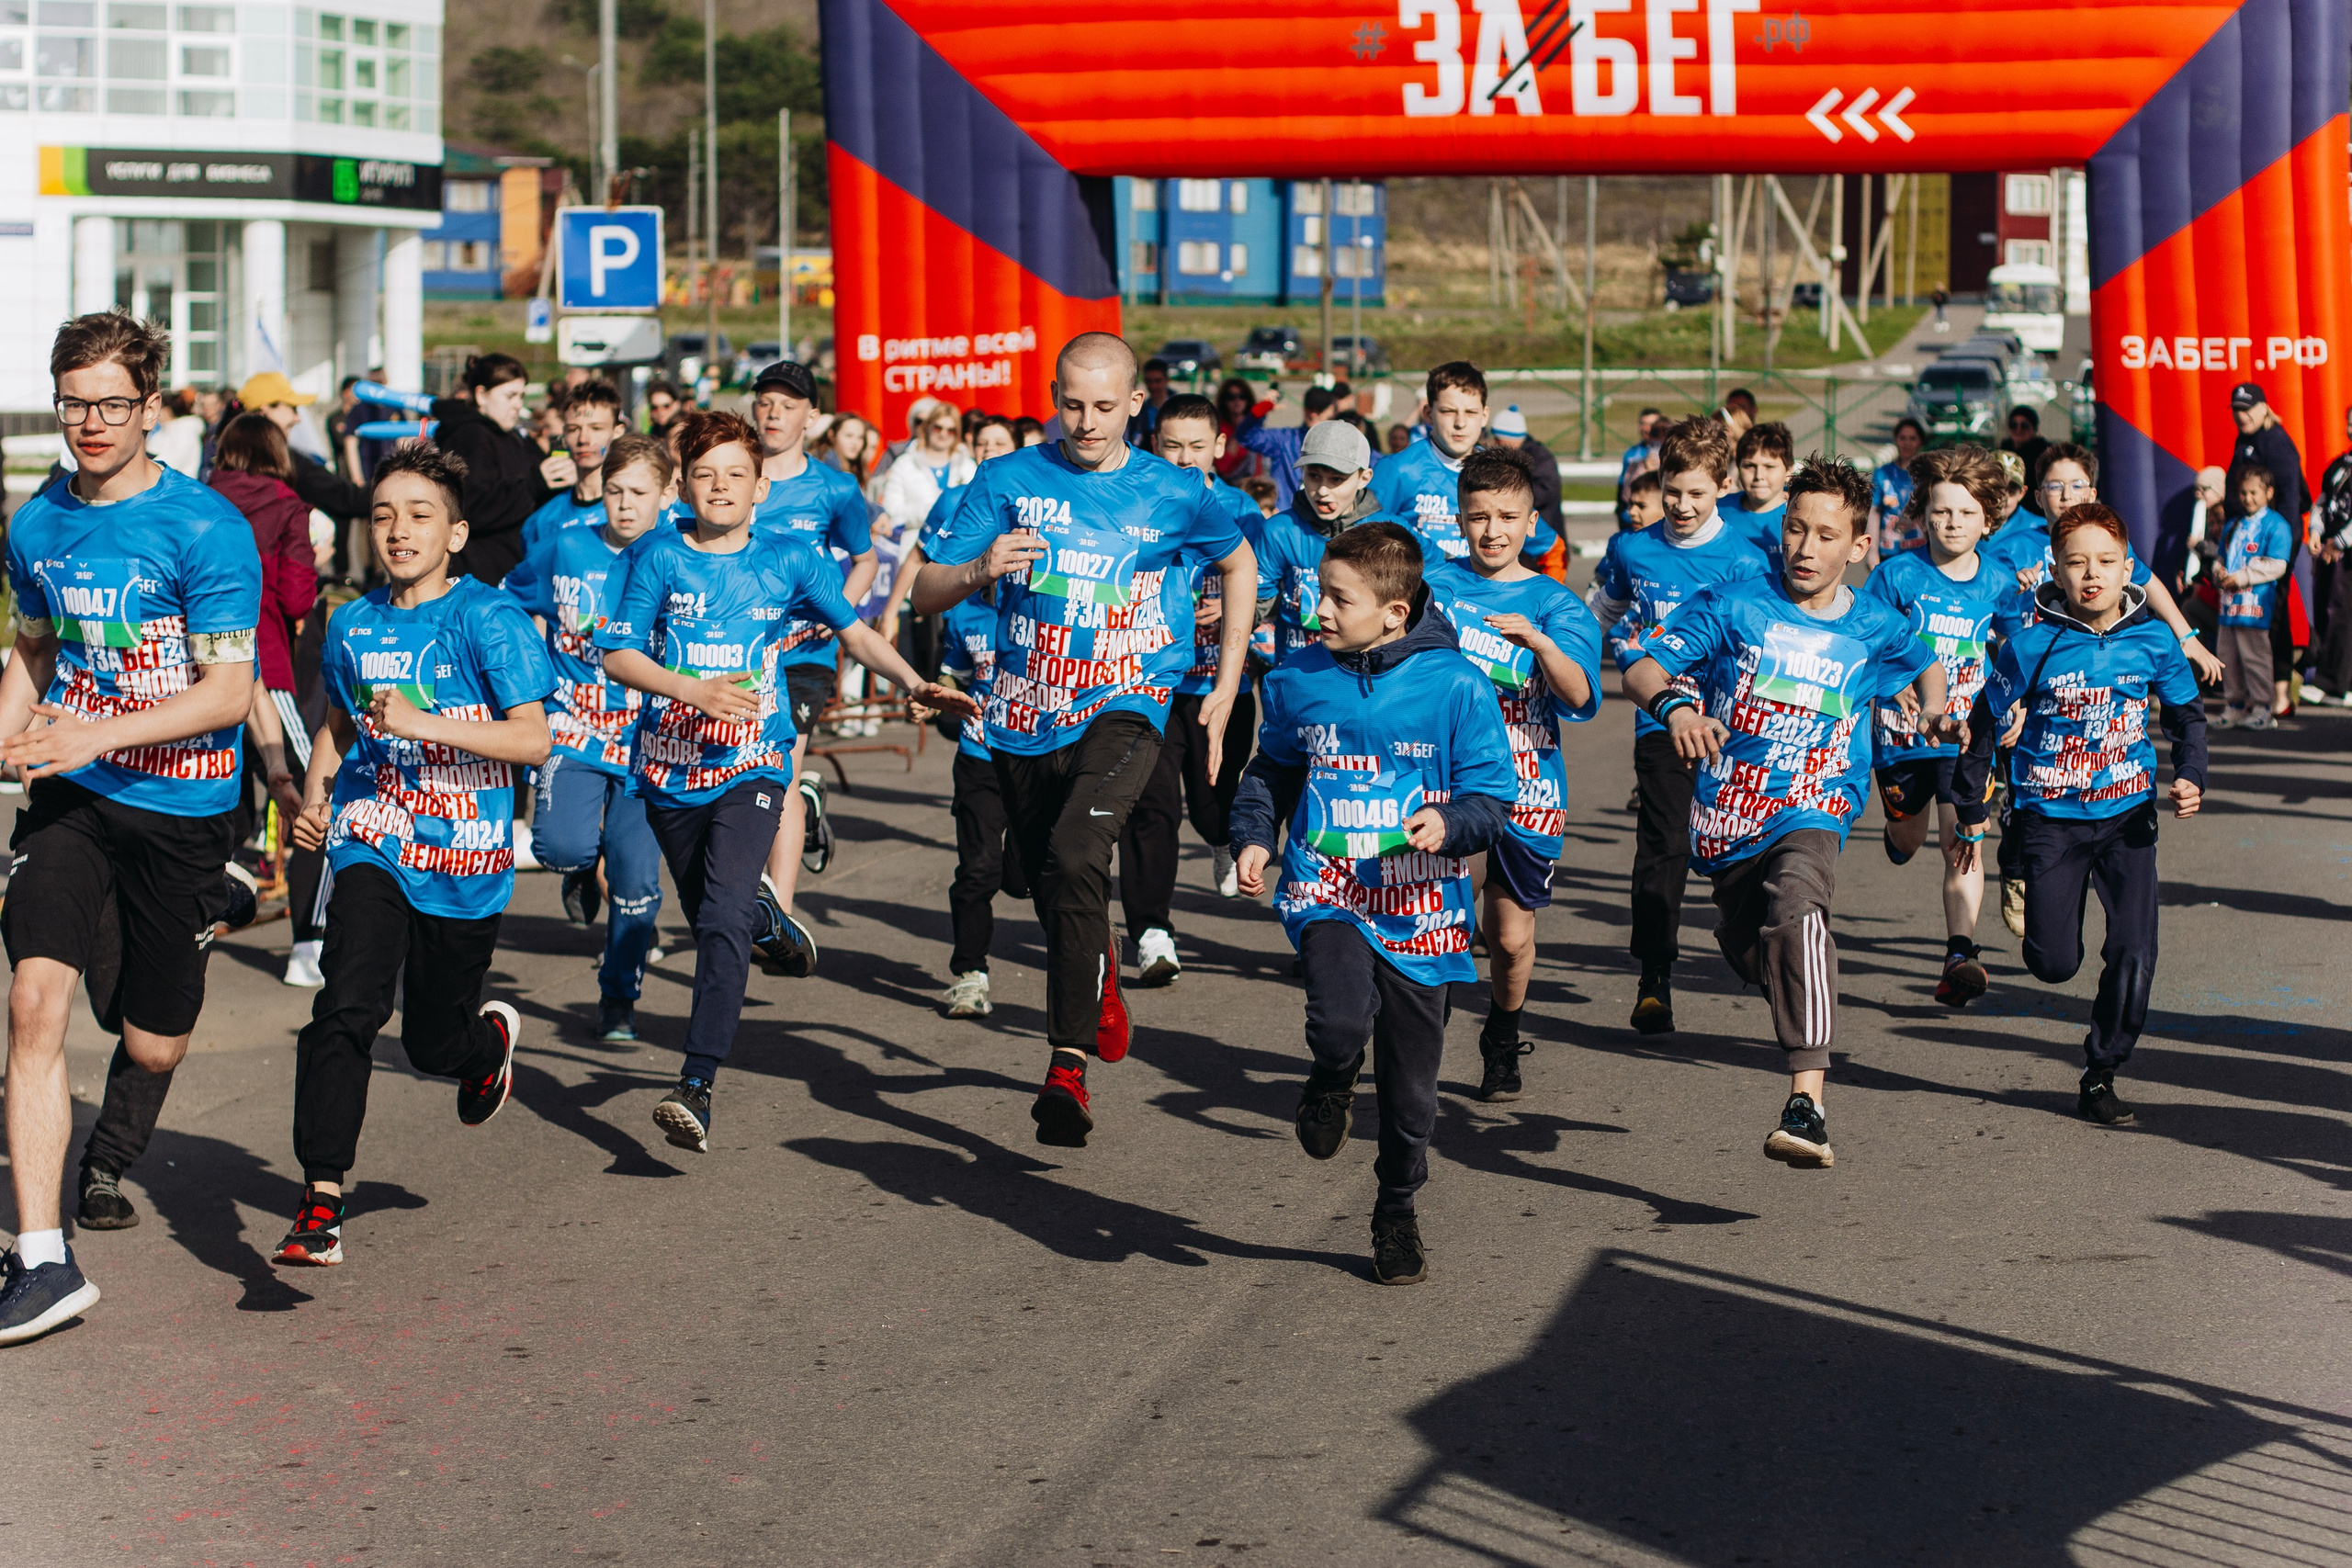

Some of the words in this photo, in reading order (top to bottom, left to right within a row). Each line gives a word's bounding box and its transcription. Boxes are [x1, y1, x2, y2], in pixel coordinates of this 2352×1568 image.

[590, 225, 640, 298] P
[857, 334, 880, 361] В
[884, 335, 970, 363] ритме
[2120, 335, 2328, 371] ЗАБЕГ.РФ
[884, 359, 1012, 393] СТРАНЫ!
[1015, 496, 1072, 526] 2024
[1414, 494, 1449, 514] 2024
[1057, 547, 1114, 580] 10027
[62, 586, 118, 617] 10047
[552, 575, 581, 605] 202
[1067, 577, 1096, 602] 1КМ
[606, 622, 632, 636] ПСБ
[1009, 612, 1072, 657] #ЗАБЕГ
[1782, 626, 1799, 635] ПСБ
[1928, 613, 1974, 638] 10008
[686, 642, 744, 668] 10003
[965, 634, 988, 651] 2024
[1459, 625, 1514, 663] 10058
[1736, 641, 1762, 674] 20
[360, 651, 413, 680] 10052
[1026, 649, 1142, 689] #ГОРДОСТЬ
[1785, 650, 1844, 688] 10023
[1795, 682, 1826, 712] 1КМ
[100, 749, 235, 780] ЕДИНСТВО
[1516, 779, 1560, 807] 2024
[1330, 798, 1398, 829] 10046
[451, 820, 505, 850] 2024
[1345, 832, 1378, 859] 1КМ
